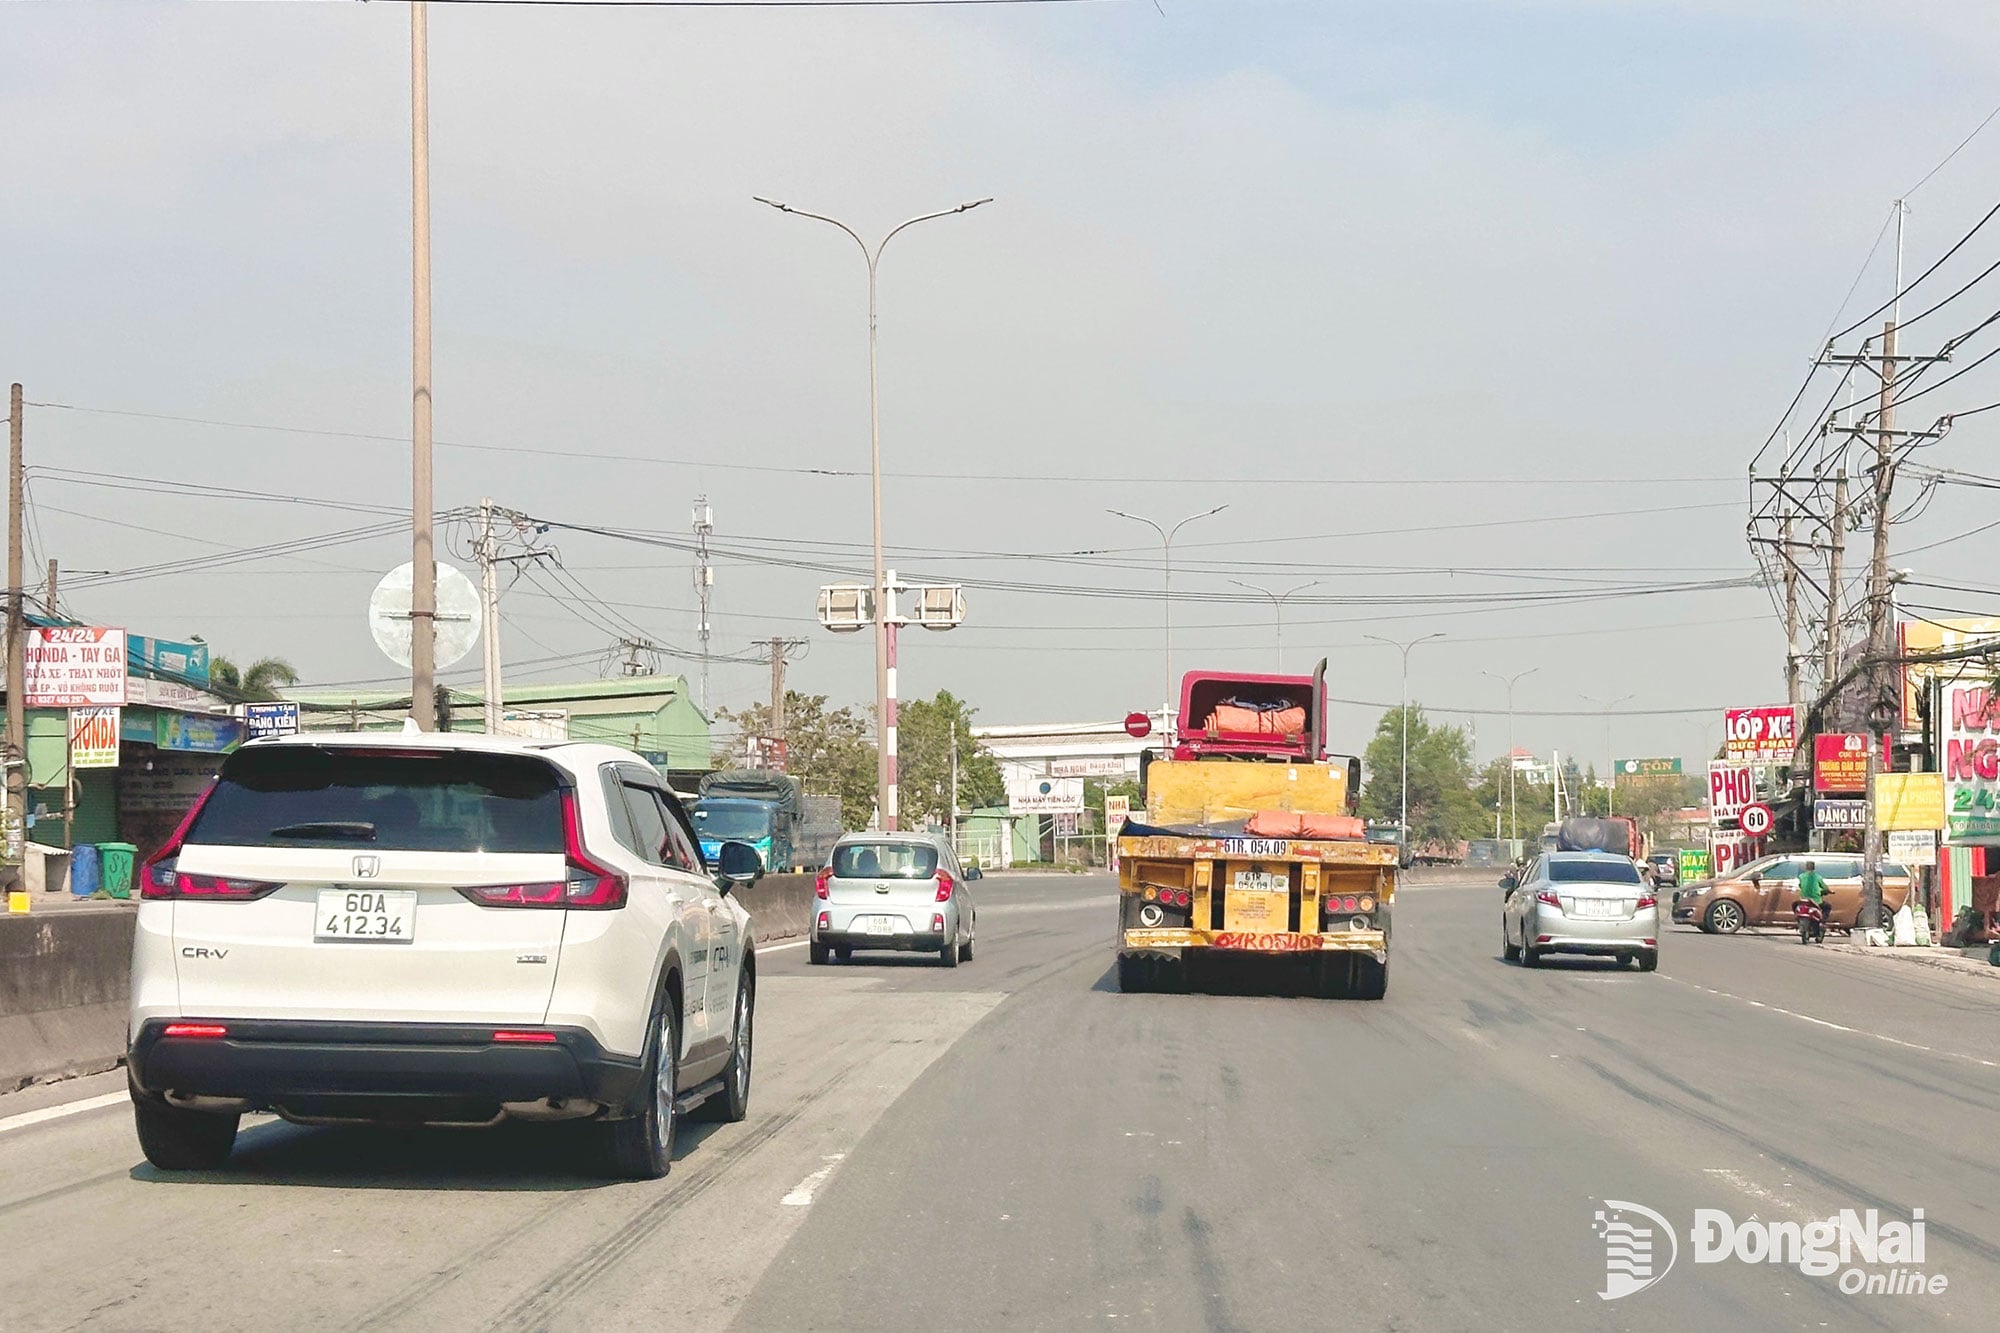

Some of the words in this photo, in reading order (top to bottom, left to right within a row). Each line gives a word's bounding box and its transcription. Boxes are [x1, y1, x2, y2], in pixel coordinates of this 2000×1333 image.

[50, 629, 95, 643] 24/24
[25, 647, 68, 663] HONDA
[80, 647, 100, 662] TAY
[104, 647, 121, 662] GA
[48, 668, 61, 679] XE
[69, 668, 94, 679] THAY
[248, 714, 274, 729] ĐĂNG
[274, 710, 297, 728] KIỂM
[1727, 709, 1763, 740] LỐP
[1767, 715, 1792, 739] XE
[74, 717, 116, 750] HONDA
[1947, 739, 2000, 781] NG
[1748, 812, 1764, 827] 60
[1817, 805, 1848, 823] ĐĂNG
[1250, 840, 1287, 855] 054.09
[346, 893, 386, 913] 60A
[326, 915, 402, 935] 412.34
[182, 947, 229, 959] CR-V
